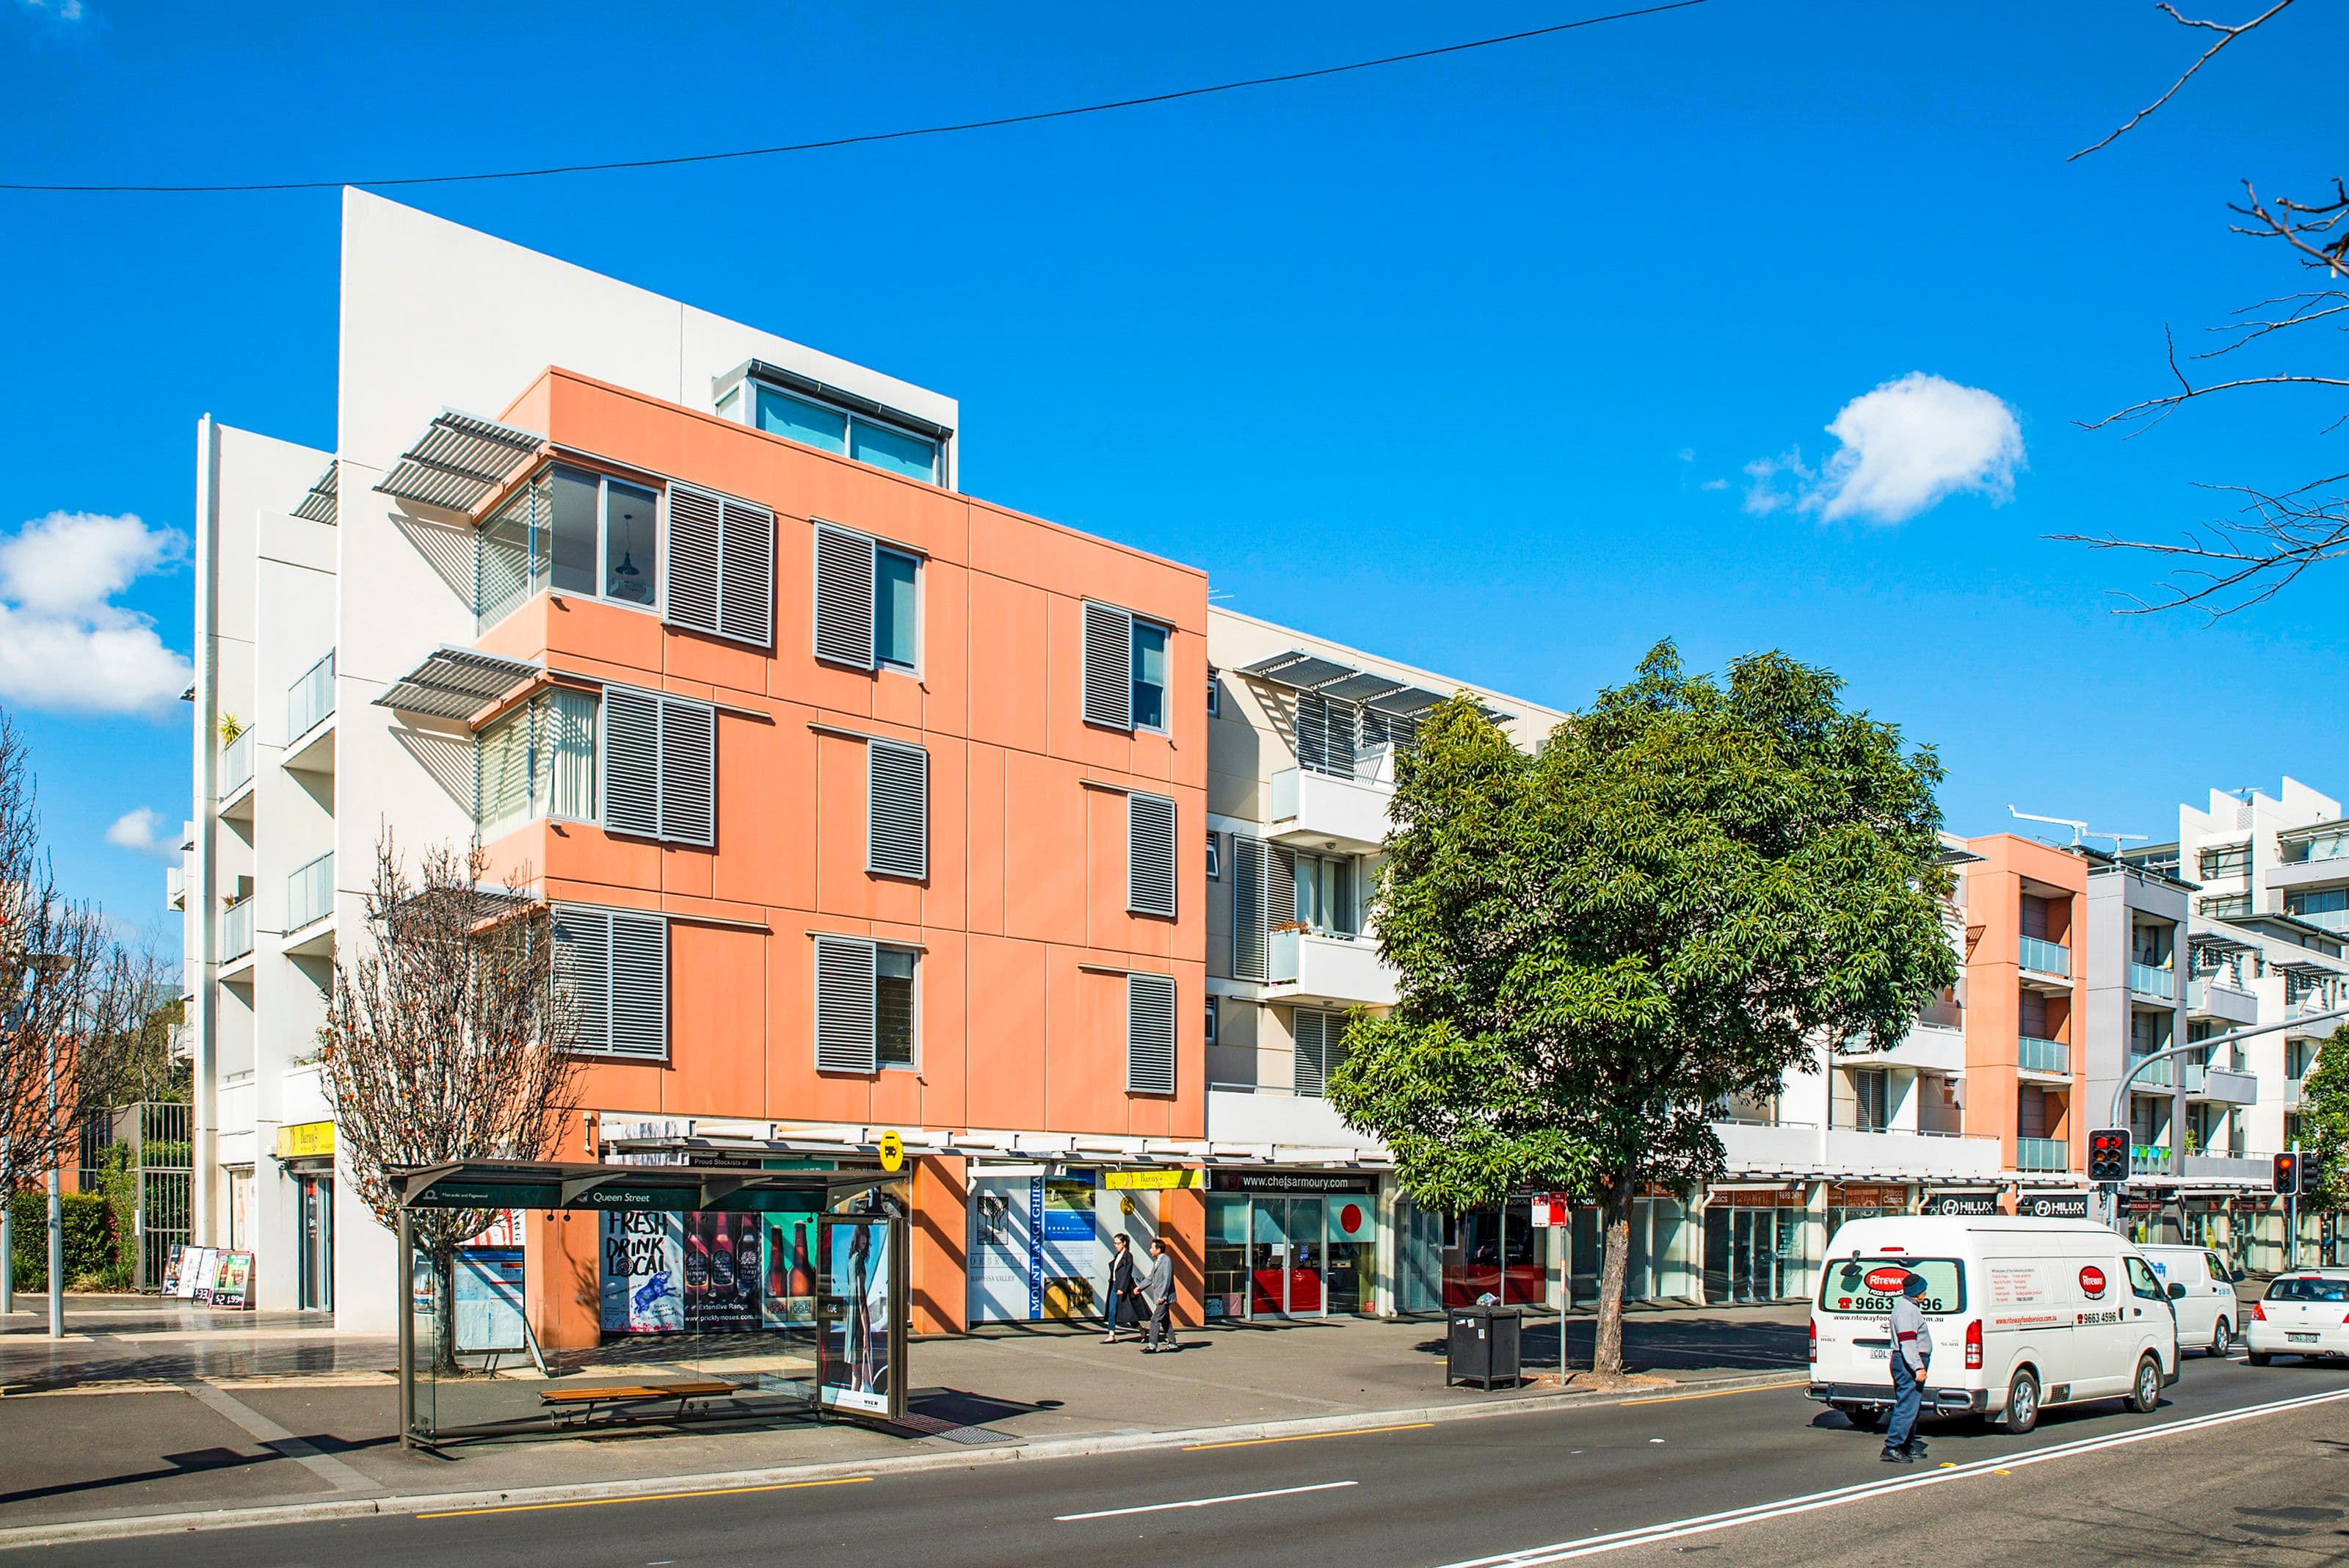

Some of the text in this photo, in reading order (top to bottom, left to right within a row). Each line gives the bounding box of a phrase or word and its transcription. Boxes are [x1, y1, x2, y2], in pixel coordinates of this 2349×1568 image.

[1244, 1175, 1348, 1190] www.chefsarmoury.com
[593, 1192, 650, 1202] Queen Street
[1959, 1201, 1994, 1211] HILUX
[2051, 1202, 2085, 1211] HILUX
[608, 1210, 668, 1235] FRESH
[606, 1237, 664, 1257] DRINK
[1031, 1222, 1040, 1260] LANGI
[609, 1255, 665, 1277] LOCAL
[1031, 1262, 1040, 1312] MOUNT
[728, 1303, 748, 1311] Range
[827, 1304, 837, 1313] CUE
[1856, 1297, 1894, 1310] 9663
[2083, 1312, 2116, 1324] 9663 4596
[1874, 1349, 1887, 1358] CDL
